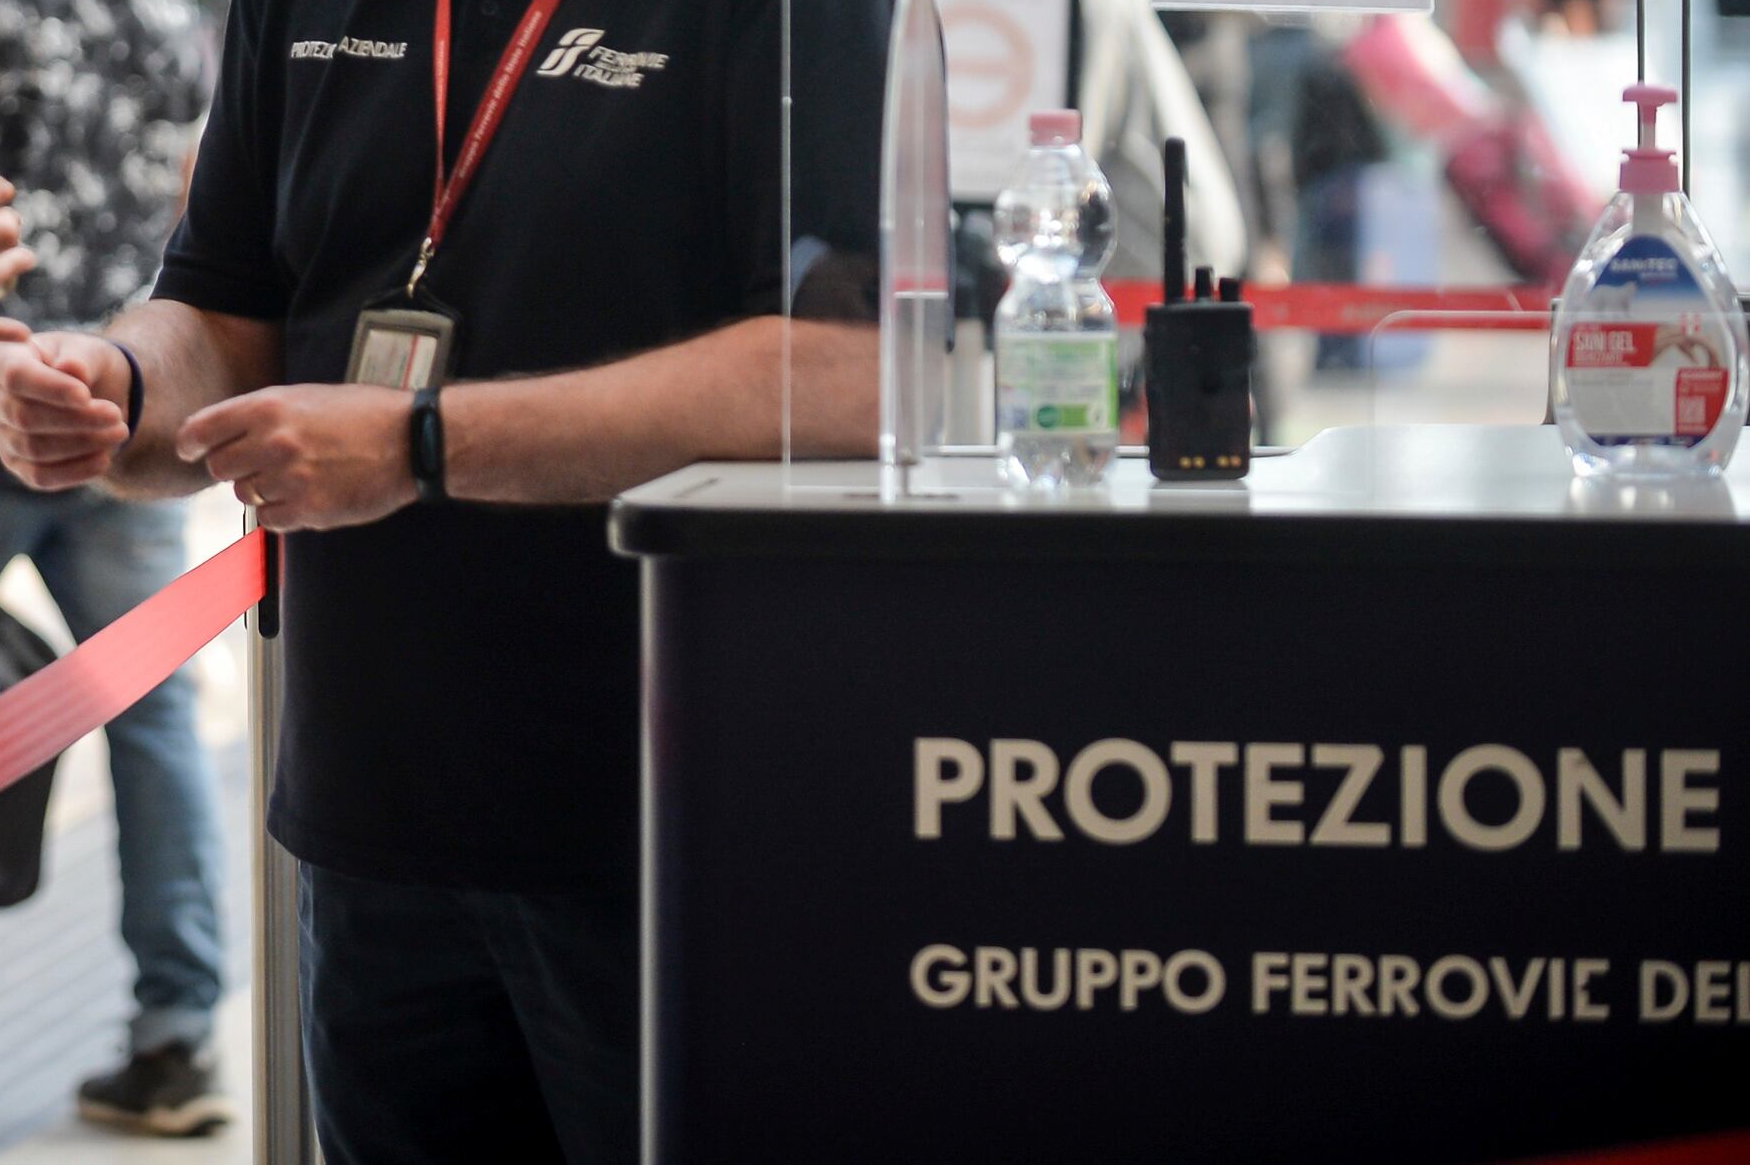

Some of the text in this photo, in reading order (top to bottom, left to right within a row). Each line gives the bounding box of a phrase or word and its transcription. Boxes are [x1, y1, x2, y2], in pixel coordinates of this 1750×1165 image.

[913, 737, 1721, 852] PROTEZIONE
[910, 943, 1227, 1014] GRUPPO
[1251, 951, 1610, 1021] FERROVIE
